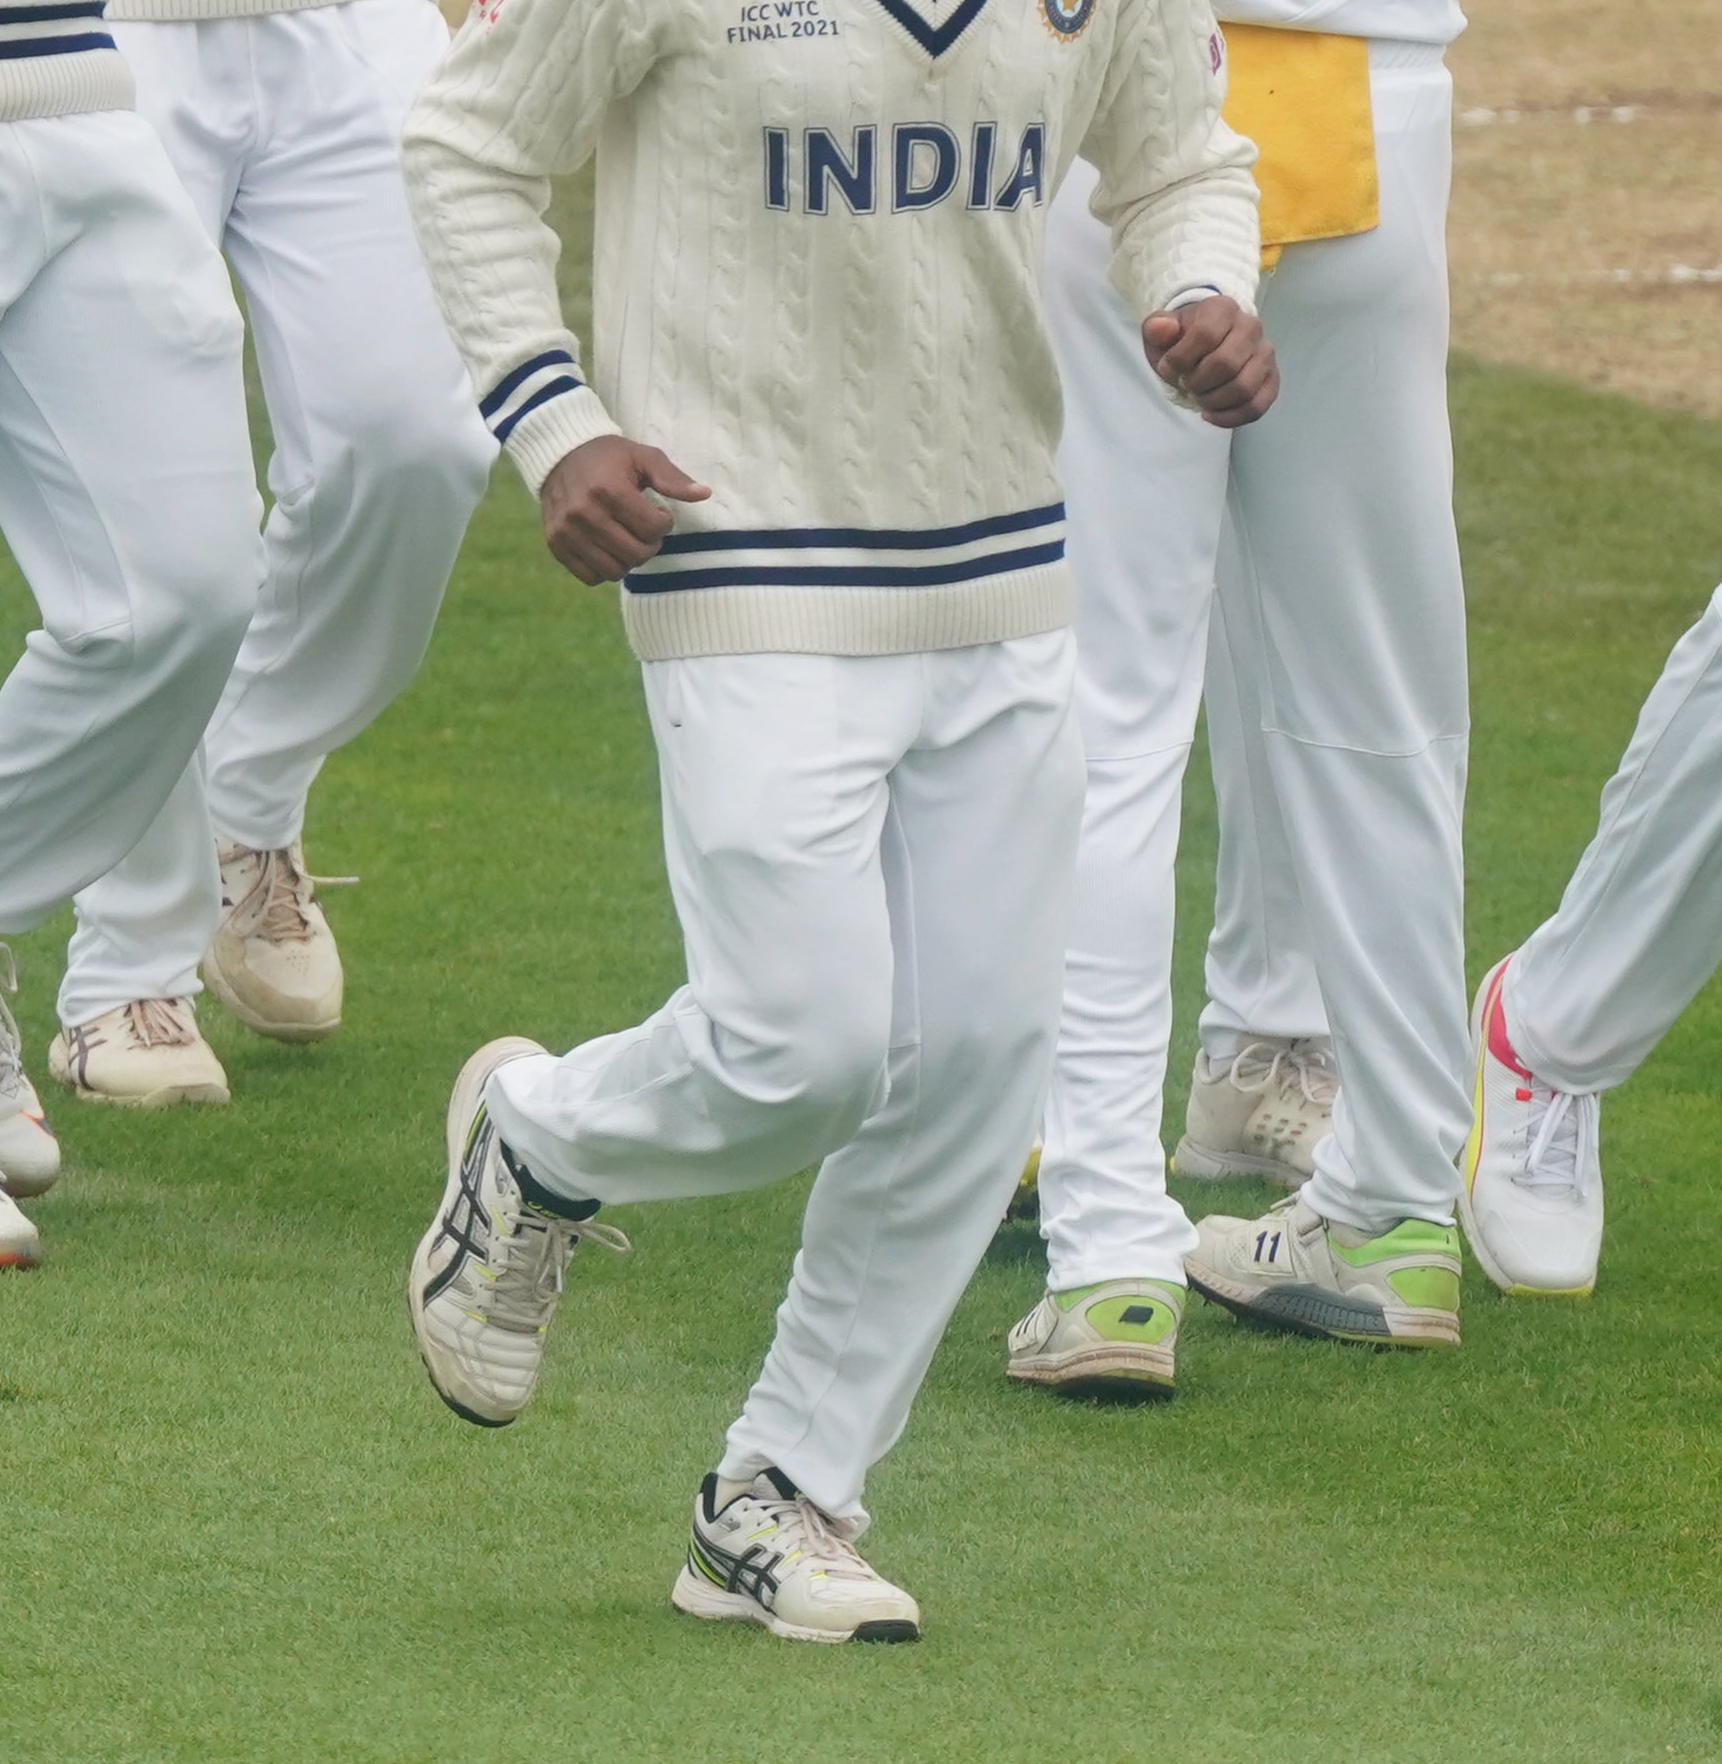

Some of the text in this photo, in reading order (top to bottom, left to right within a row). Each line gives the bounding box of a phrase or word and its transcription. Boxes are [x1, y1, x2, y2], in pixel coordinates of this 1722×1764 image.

[740, 0, 820, 22] ICC WTC
[727, 19, 840, 44] FINAL 2021
[762, 121, 1045, 216] INDIA
[1253, 1230, 1281, 1263] 11
